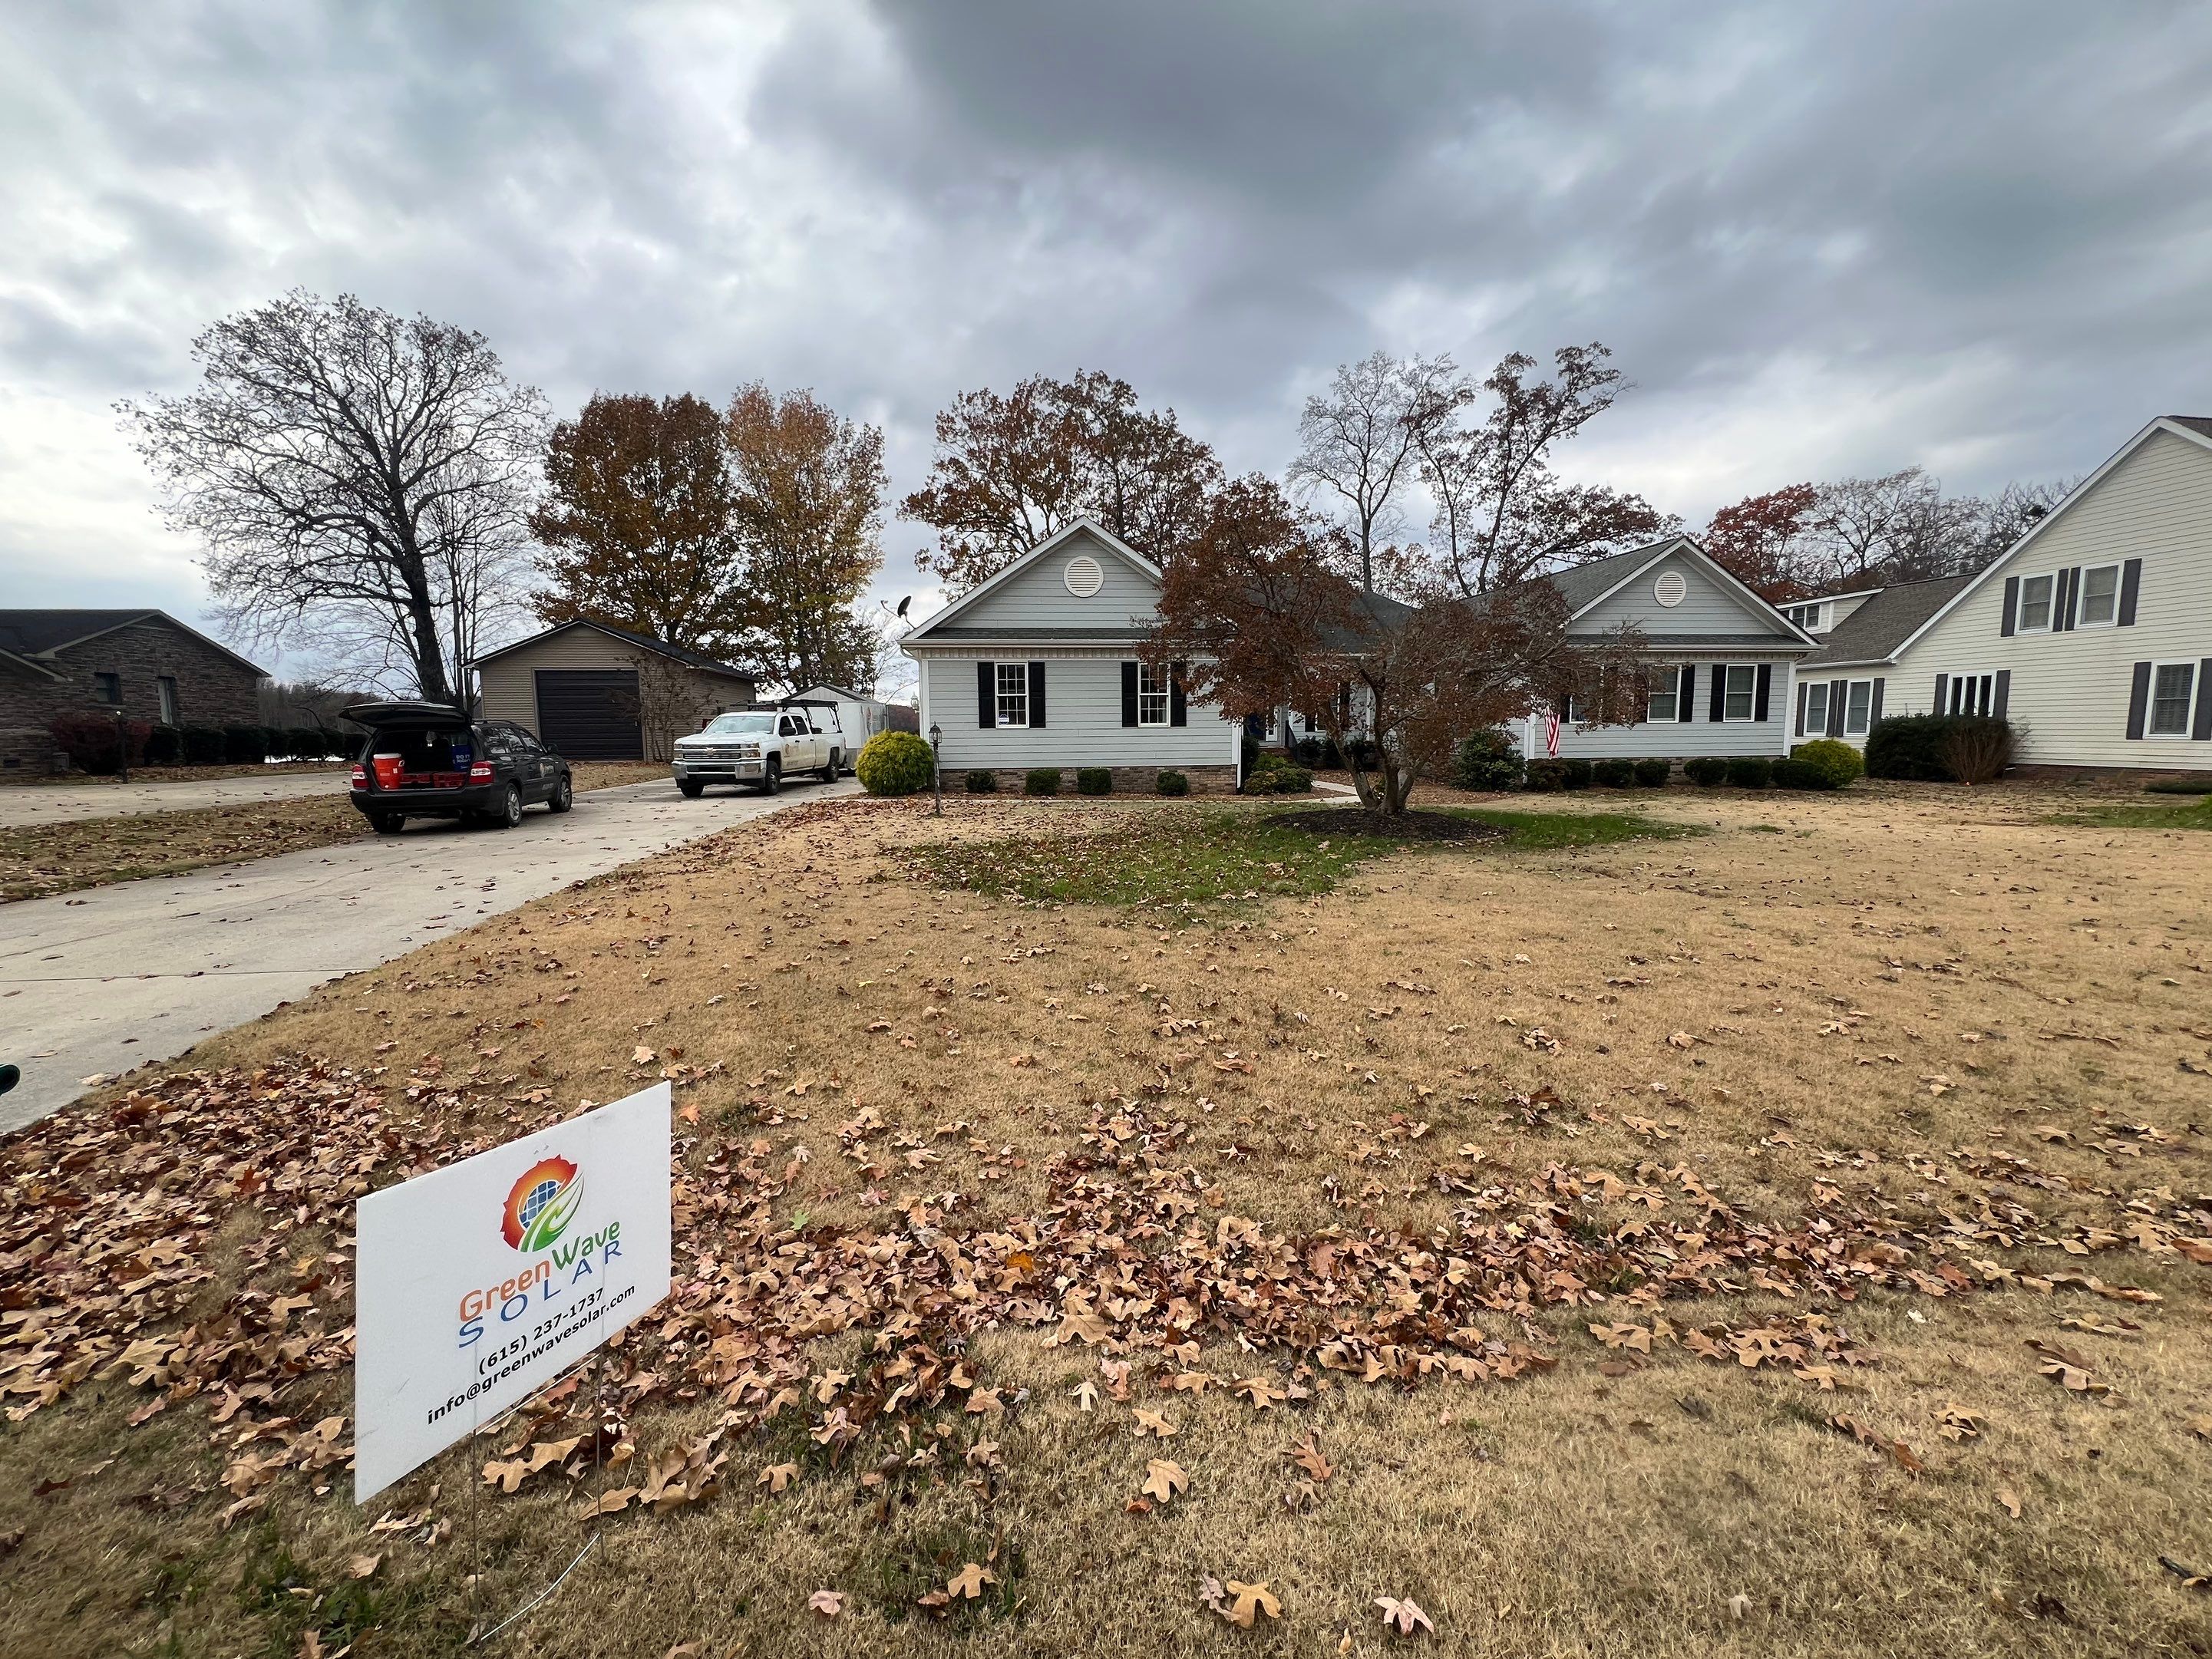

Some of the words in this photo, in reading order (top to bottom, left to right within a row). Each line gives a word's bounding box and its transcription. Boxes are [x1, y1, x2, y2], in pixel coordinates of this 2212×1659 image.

[458, 1240, 622, 1348] SOLAR
[479, 1334, 527, 1375] (615)
[533, 1287, 604, 1341] 237-1737
[428, 1285, 636, 1424] info@greenwavesolar.com
